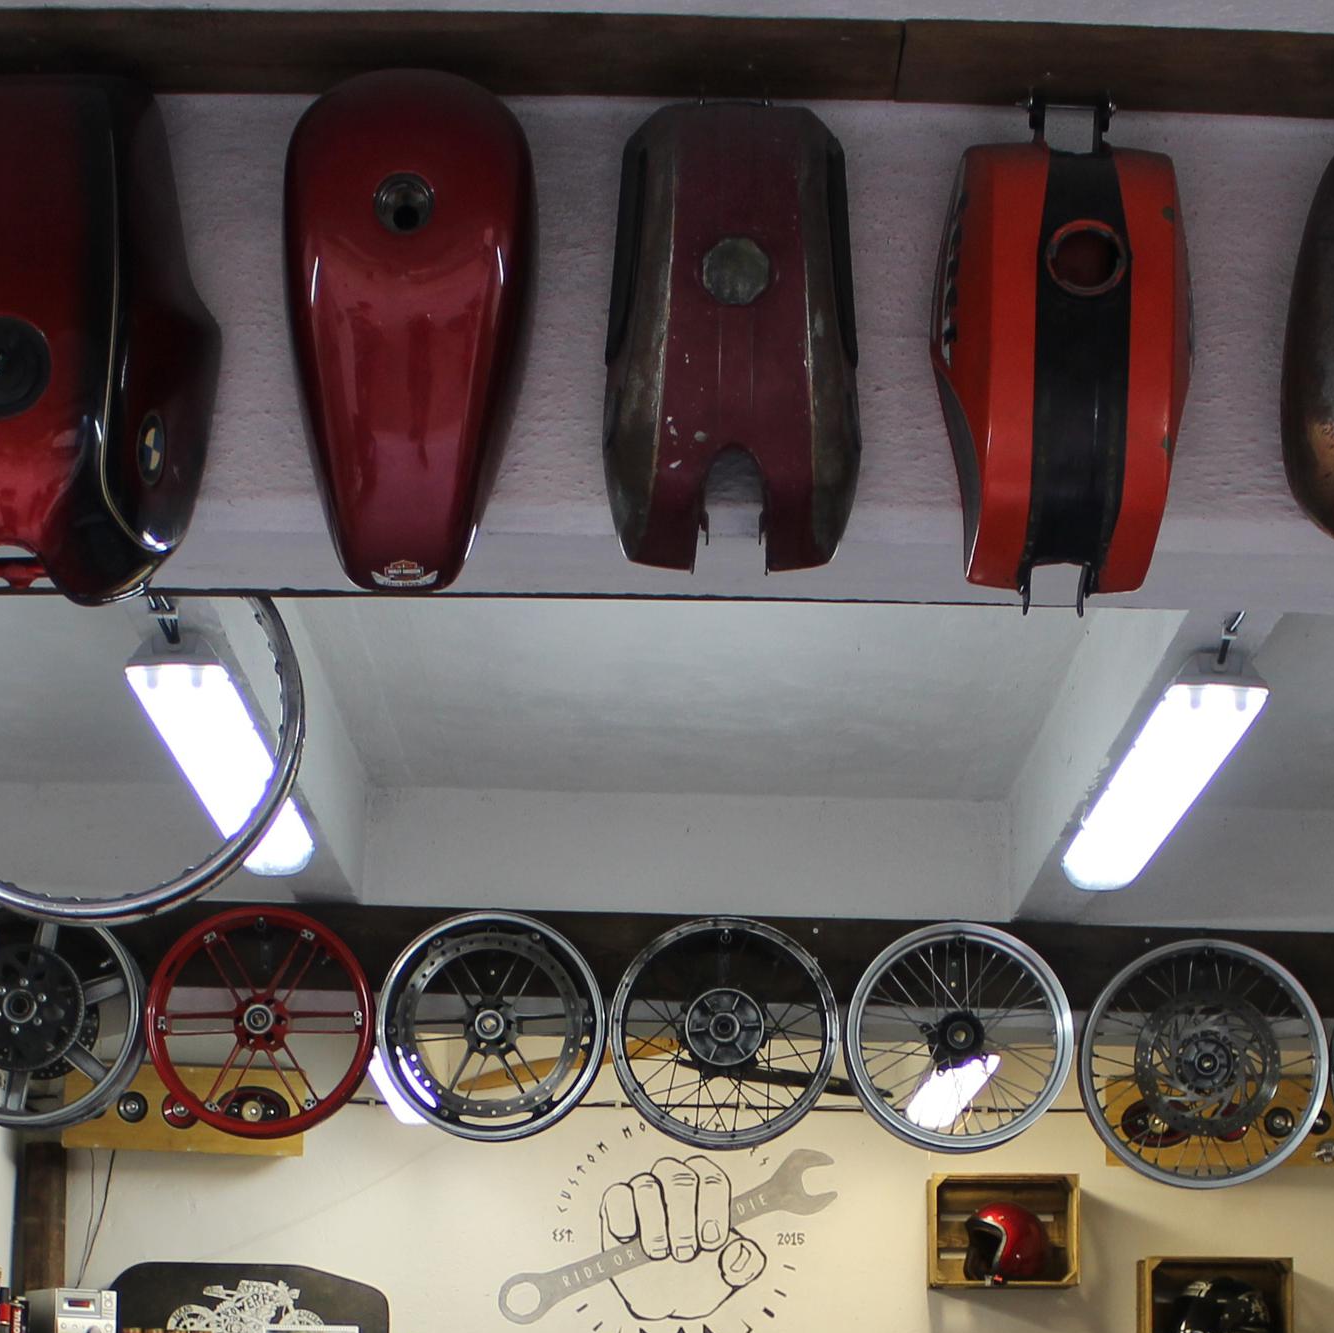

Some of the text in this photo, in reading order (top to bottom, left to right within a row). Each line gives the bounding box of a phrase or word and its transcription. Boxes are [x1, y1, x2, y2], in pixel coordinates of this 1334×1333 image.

[556, 1141, 609, 1213] CUSTOM
[735, 1193, 768, 1216] DIE
[776, 1231, 805, 1246] 2015
[562, 1247, 637, 1289] RIDE OR
